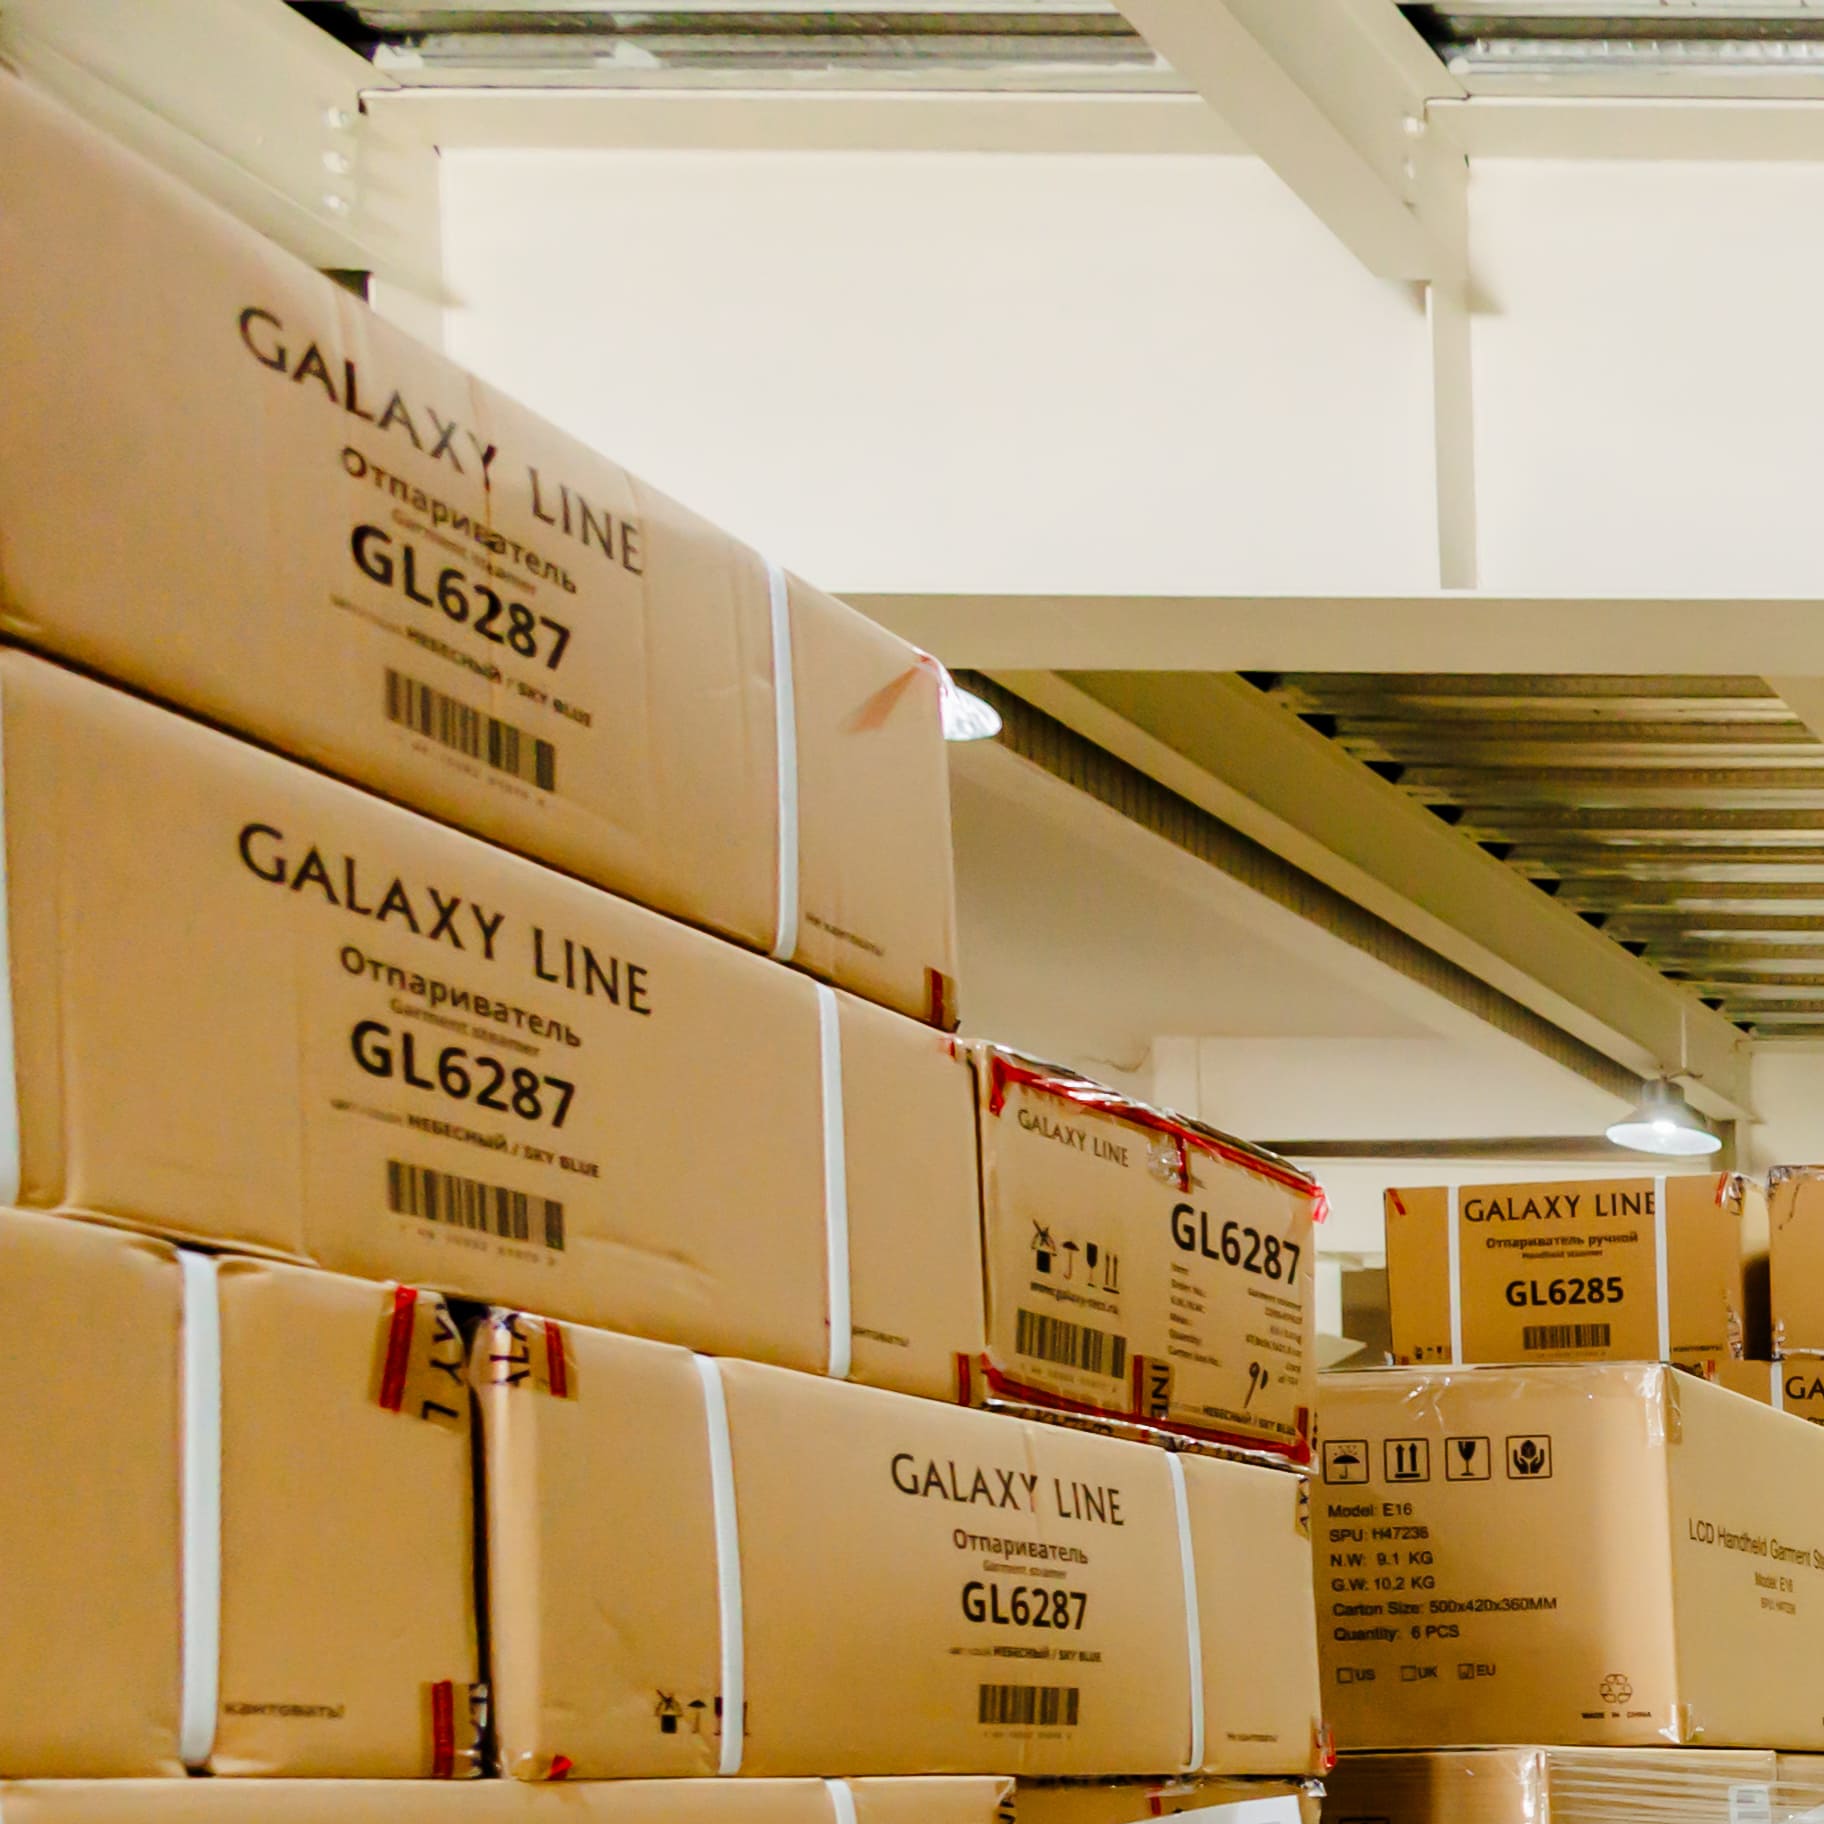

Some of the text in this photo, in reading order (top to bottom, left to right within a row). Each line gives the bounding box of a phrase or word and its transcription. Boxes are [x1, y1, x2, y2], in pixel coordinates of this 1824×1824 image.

[239, 308, 643, 575] GALAXY LINE
[341, 446, 577, 593] Отпариватель
[351, 524, 570, 670] GL6287
[238, 823, 652, 1016] GALAXY LINE
[341, 946, 581, 1047] Отпариватель
[350, 1020, 575, 1127] GL6287
[1018, 1108, 1129, 1168] GALAXY LINE
[1464, 1191, 1656, 1223] GALAXY LINE
[1171, 1203, 1300, 1285] GL6287
[1505, 1276, 1624, 1307] GL6285
[891, 1454, 1124, 1526] GALAXY LINE
[1383, 1502, 1412, 1517] E16
[953, 1529, 1088, 1564] Отпариватель
[1689, 1517, 1714, 1544] LCD
[1409, 1551, 1433, 1565] KG
[1411, 1575, 1435, 1590] KG
[962, 1581, 1088, 1630] GL6287
[1426, 1625, 1460, 1638] PCS
